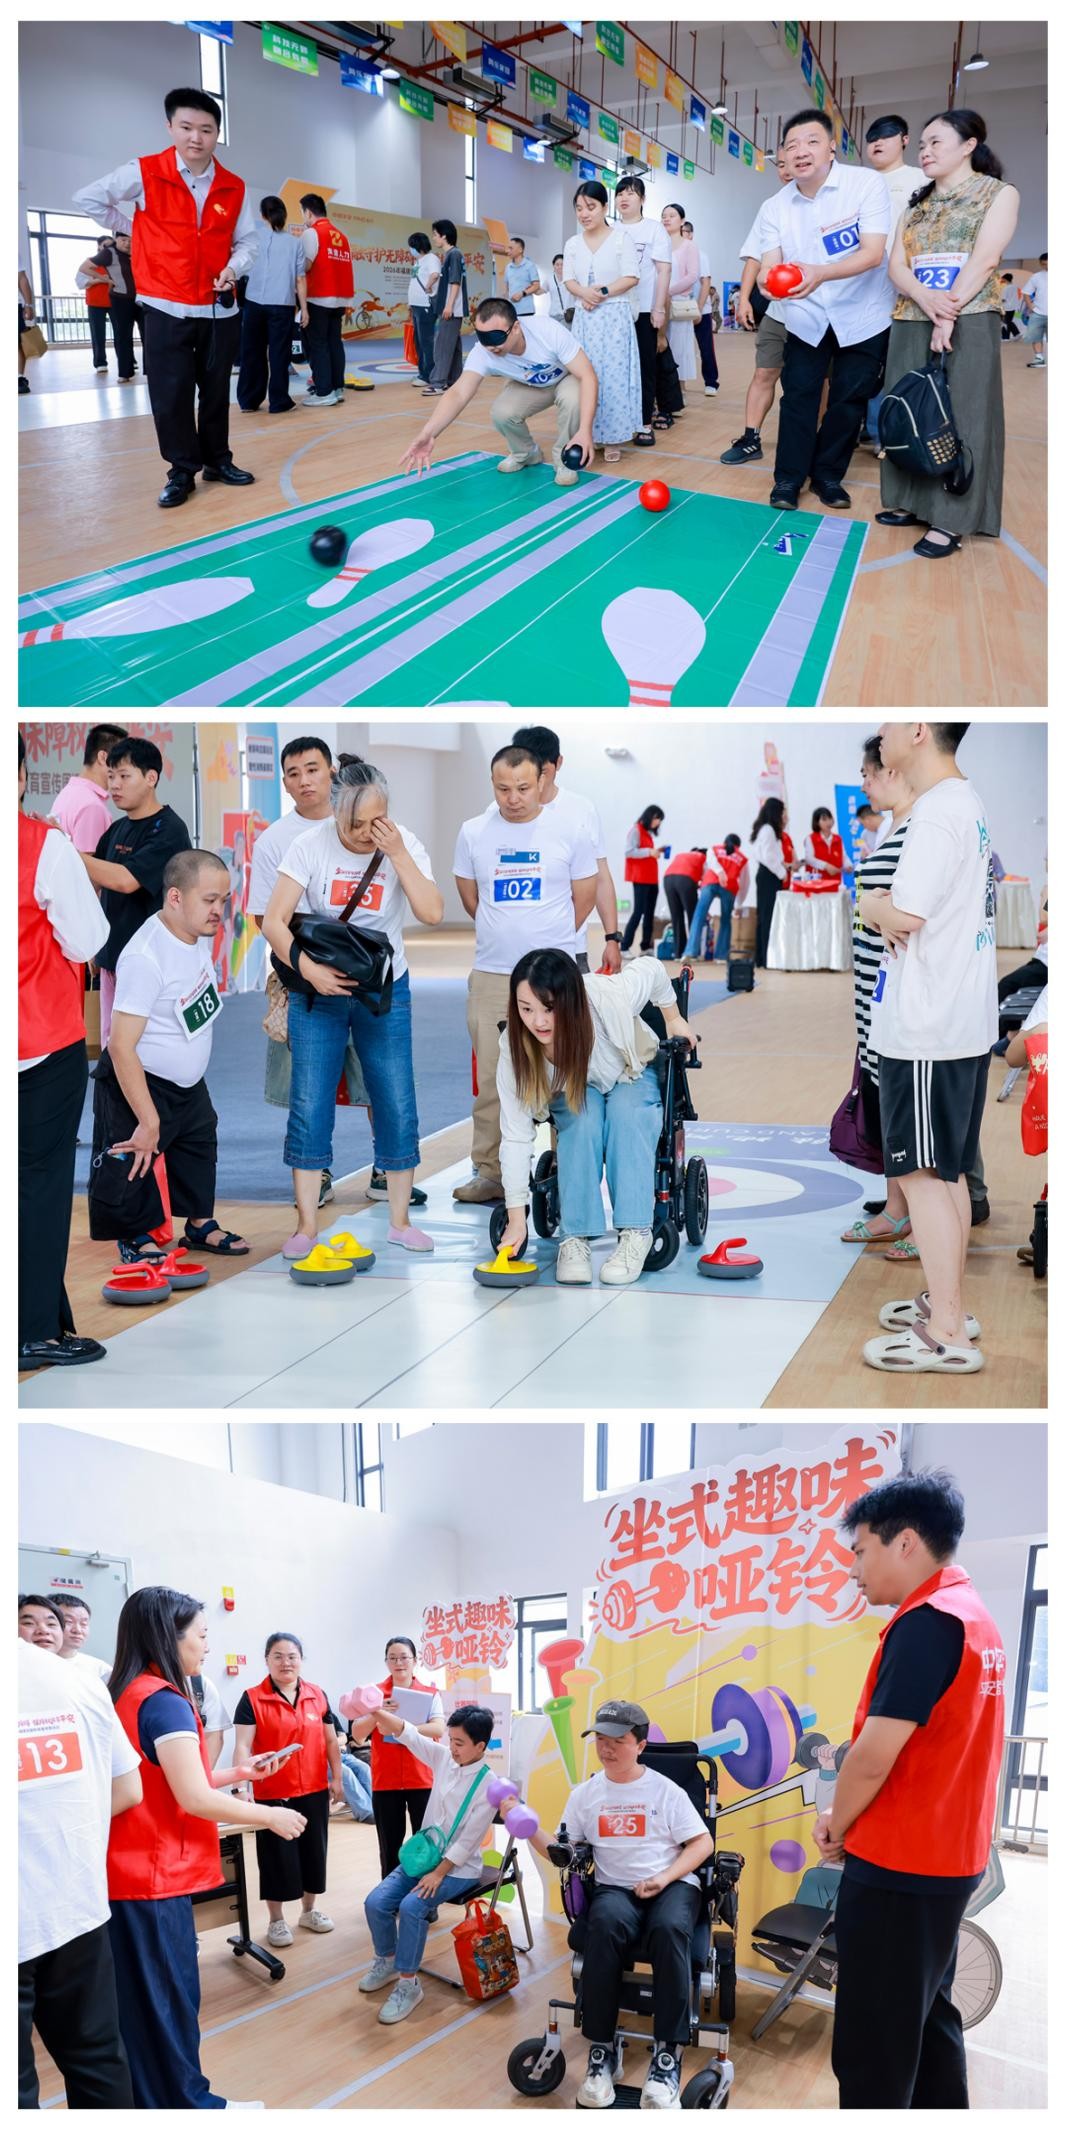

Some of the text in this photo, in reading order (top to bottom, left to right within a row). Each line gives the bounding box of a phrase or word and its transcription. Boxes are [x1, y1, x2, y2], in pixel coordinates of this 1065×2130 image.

[922, 268, 950, 288] 23
[507, 879, 533, 899] 02
[198, 993, 215, 1019] 18
[609, 1437, 884, 1573] 坐式趣味
[693, 1528, 857, 1620] 哑铃
[425, 1595, 512, 1638] 坐式趣味
[455, 1630, 507, 1664] 哑铃
[26, 1738, 68, 1774] 13
[613, 1816, 638, 1835] 25
